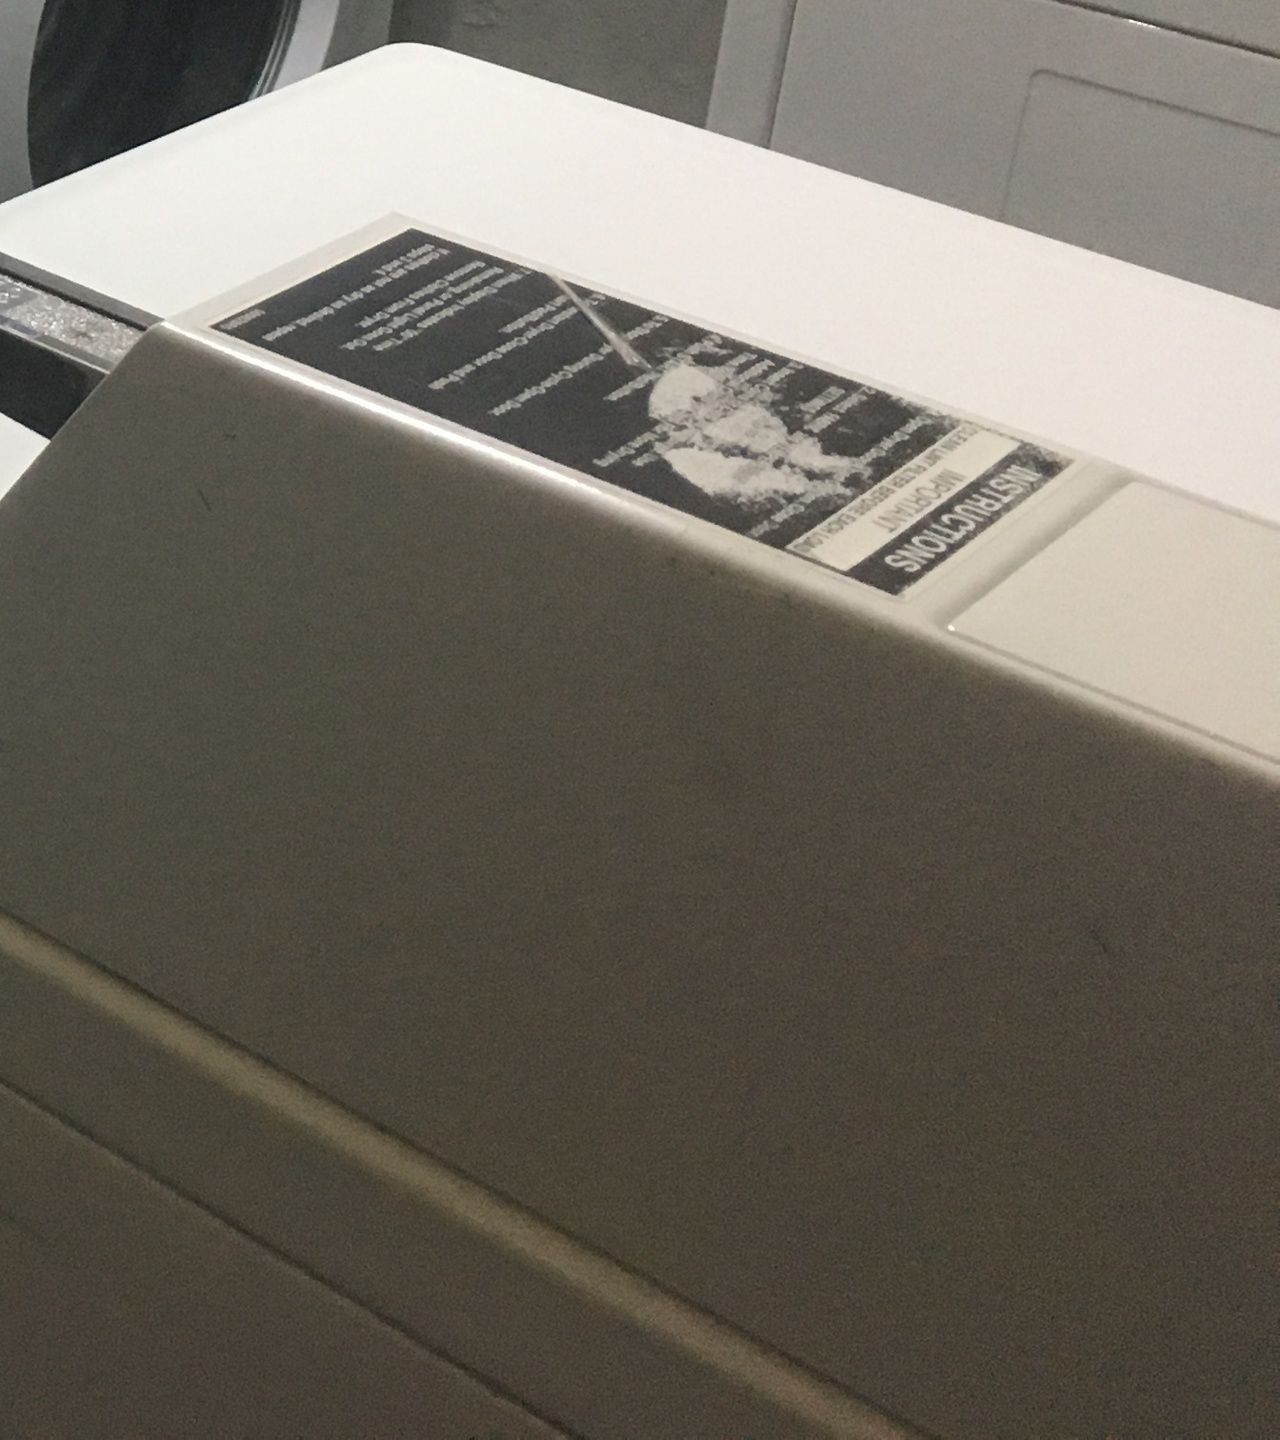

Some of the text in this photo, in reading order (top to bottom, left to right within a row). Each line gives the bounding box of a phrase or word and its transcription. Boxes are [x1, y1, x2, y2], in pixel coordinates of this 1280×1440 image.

[561, 351, 605, 373] During
[937, 425, 981, 451] CLEAN
[589, 443, 637, 469] Drying
[915, 447, 951, 467] LINT
[885, 462, 928, 488] FILTER
[846, 485, 897, 516] BEFORE
[866, 467, 968, 533] IMPORTANT
[818, 512, 857, 535] EACH
[884, 466, 1042, 574] INSTRUCTIONS
